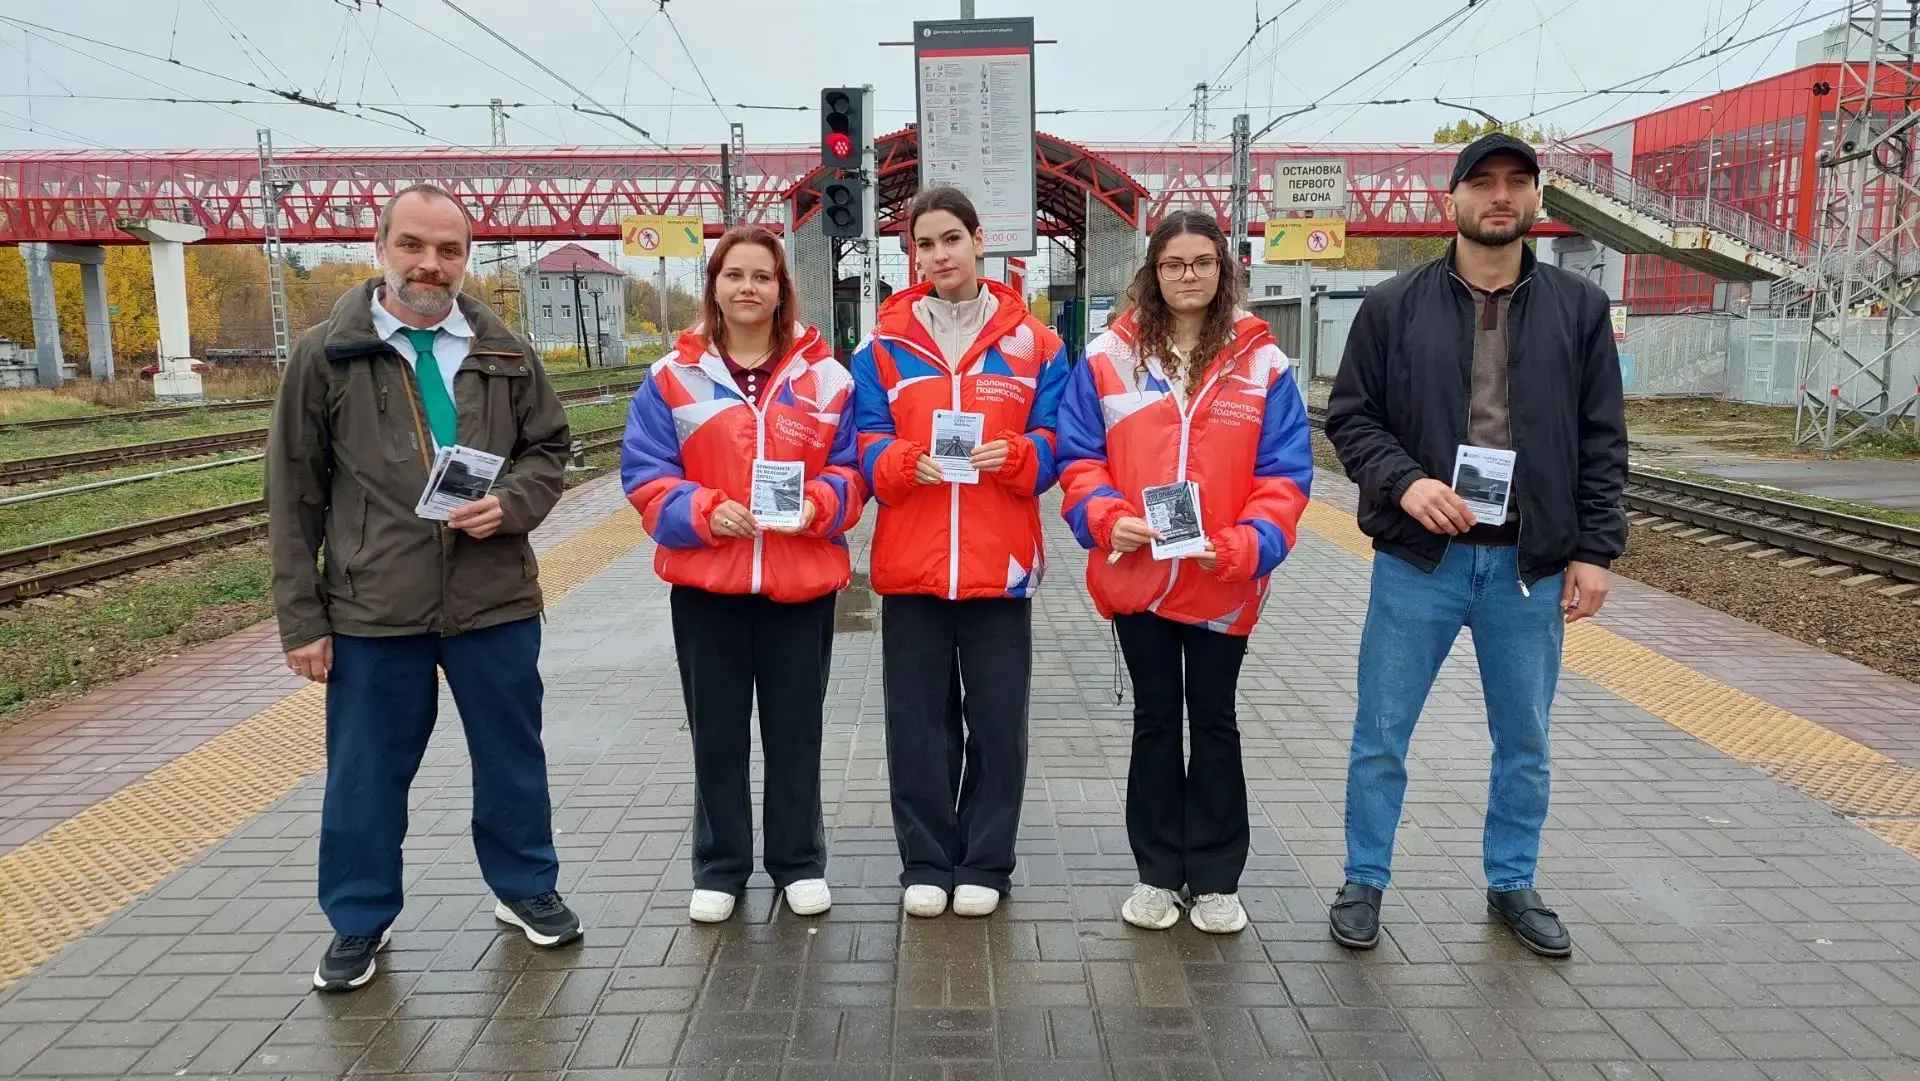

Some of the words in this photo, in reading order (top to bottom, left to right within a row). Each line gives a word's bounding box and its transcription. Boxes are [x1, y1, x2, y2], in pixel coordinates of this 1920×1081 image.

[1282, 165, 1342, 176] ОСТАНОВКА
[1289, 178, 1335, 189] ПЕРВОГО
[1292, 192, 1331, 203] ВАГОНА
[1212, 400, 1262, 415] ВОЛОНТЕРЫ
